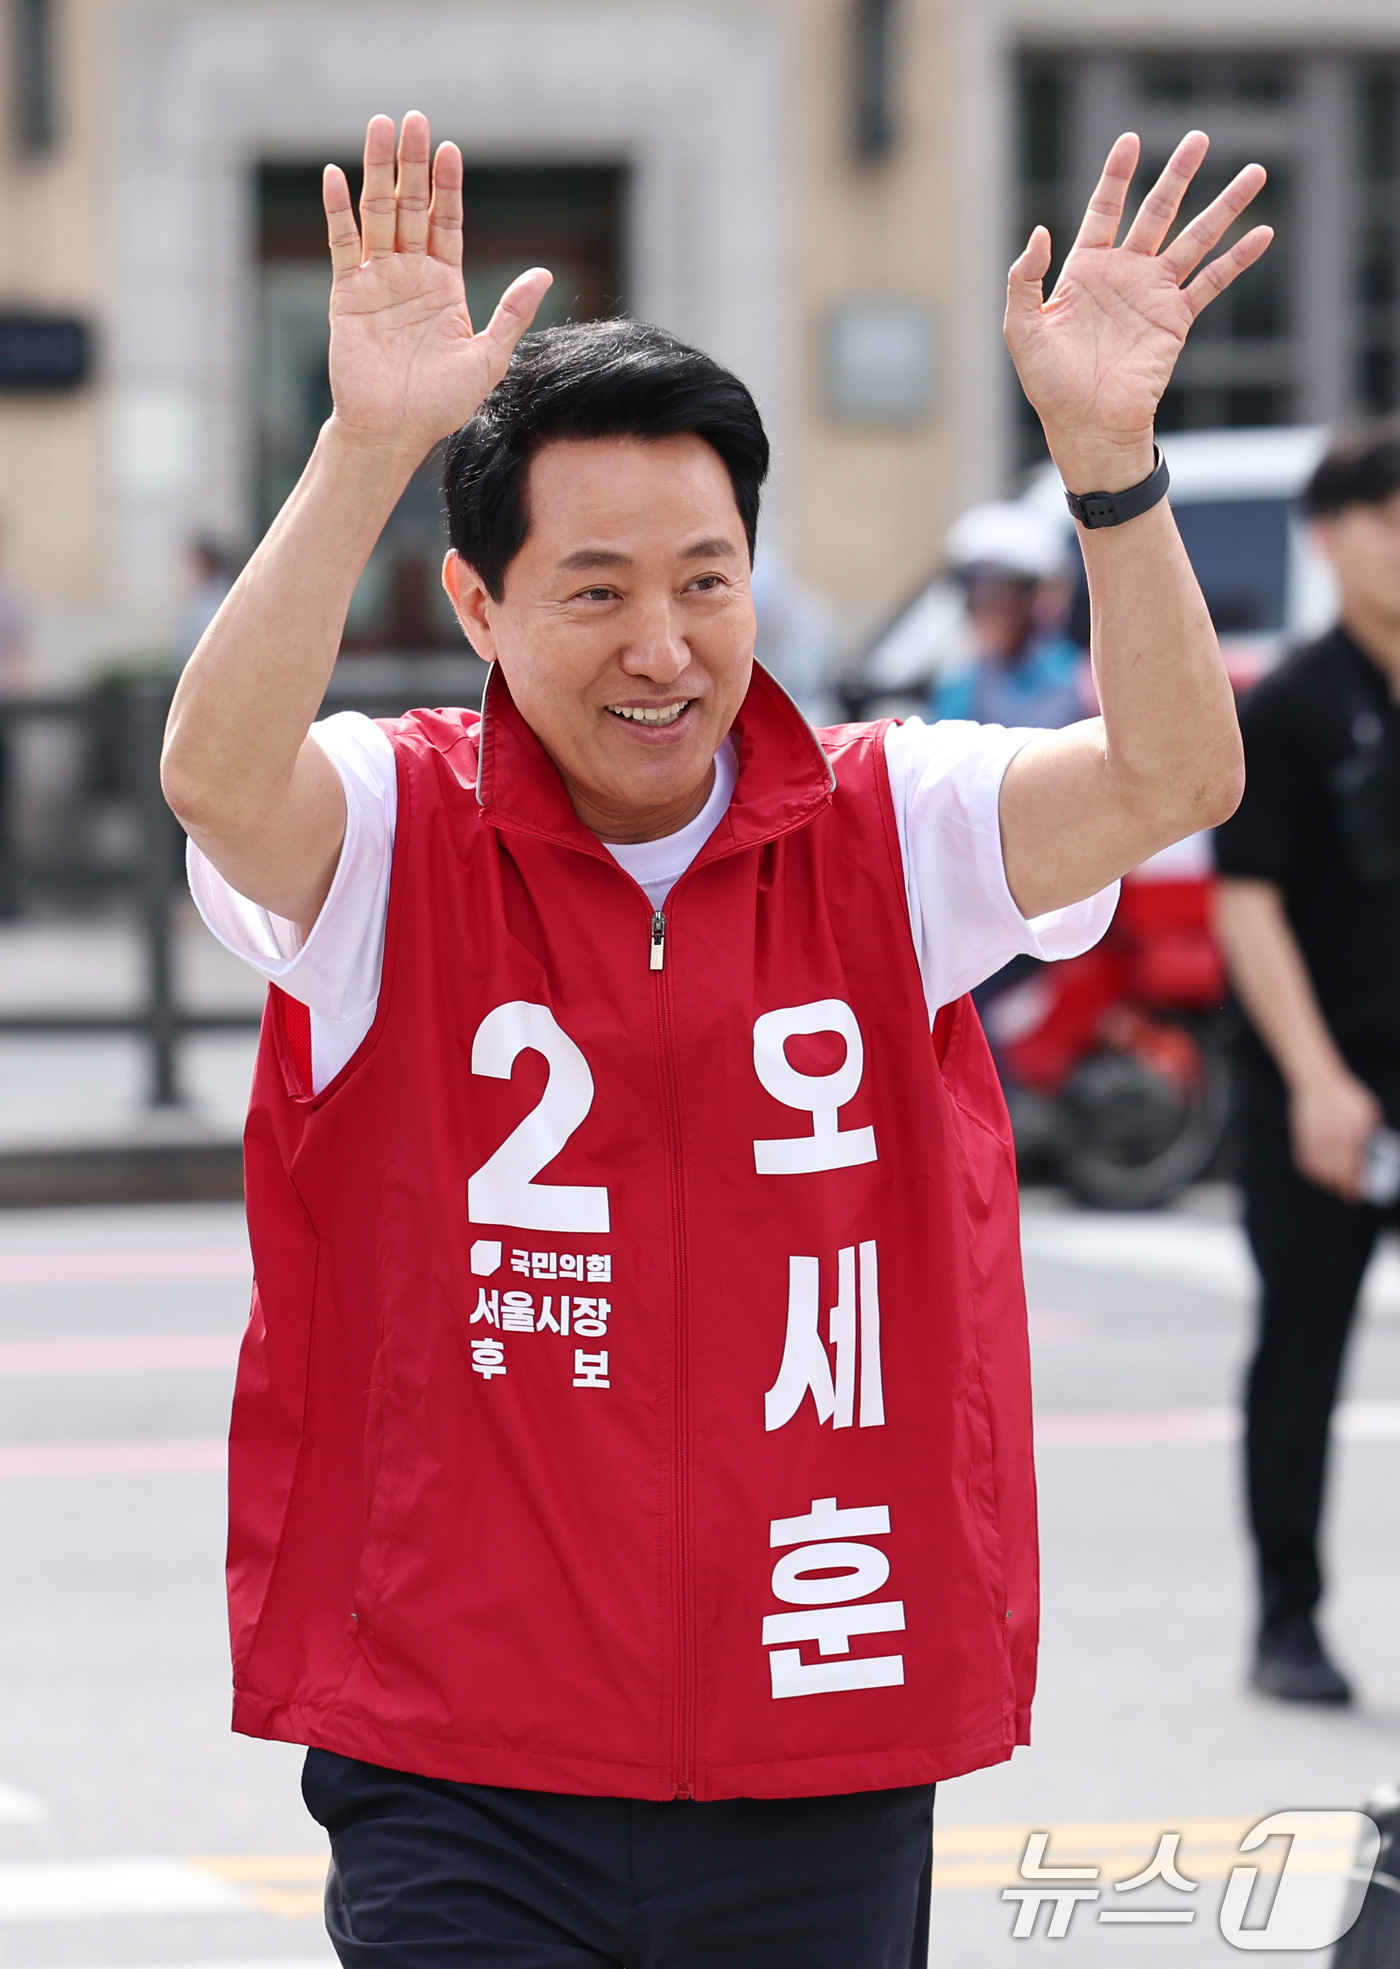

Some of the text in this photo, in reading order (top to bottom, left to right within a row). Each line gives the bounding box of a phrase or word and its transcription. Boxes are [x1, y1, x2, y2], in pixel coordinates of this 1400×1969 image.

[468, 1000, 611, 1234] 2
[469, 1287, 612, 1338] 서울시장
[510, 1248, 612, 1283] 국민의힘
[752, 998, 907, 1700] 오세훈
